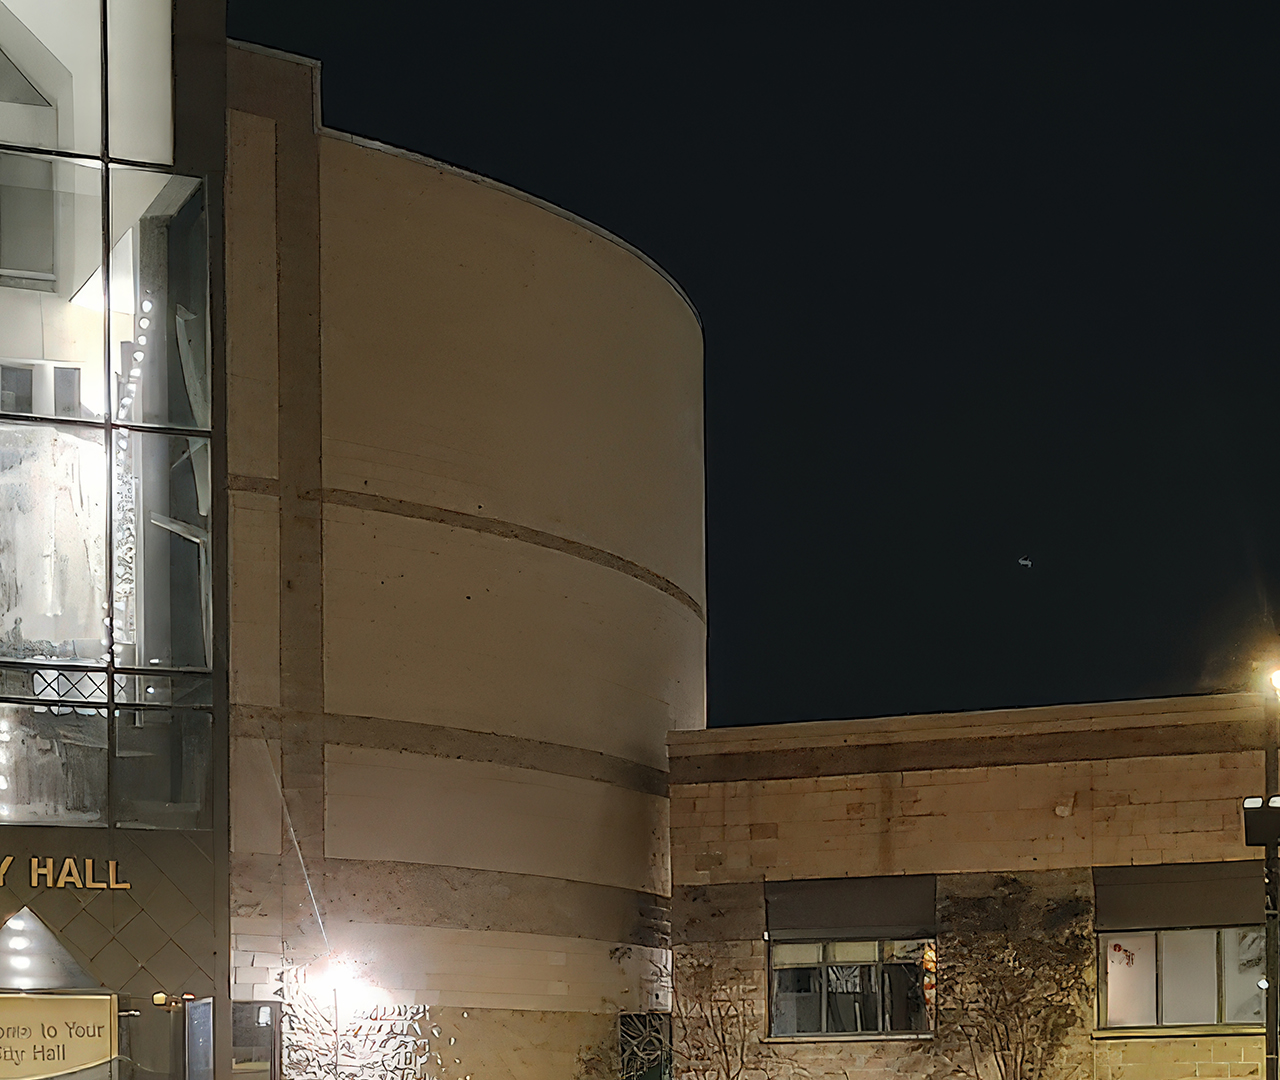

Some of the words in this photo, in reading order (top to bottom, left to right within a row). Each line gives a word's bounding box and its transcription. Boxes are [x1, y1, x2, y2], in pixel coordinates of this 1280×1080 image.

[29, 855, 132, 890] HALL
[65, 1021, 105, 1039] Your
[33, 1044, 66, 1062] Hall
